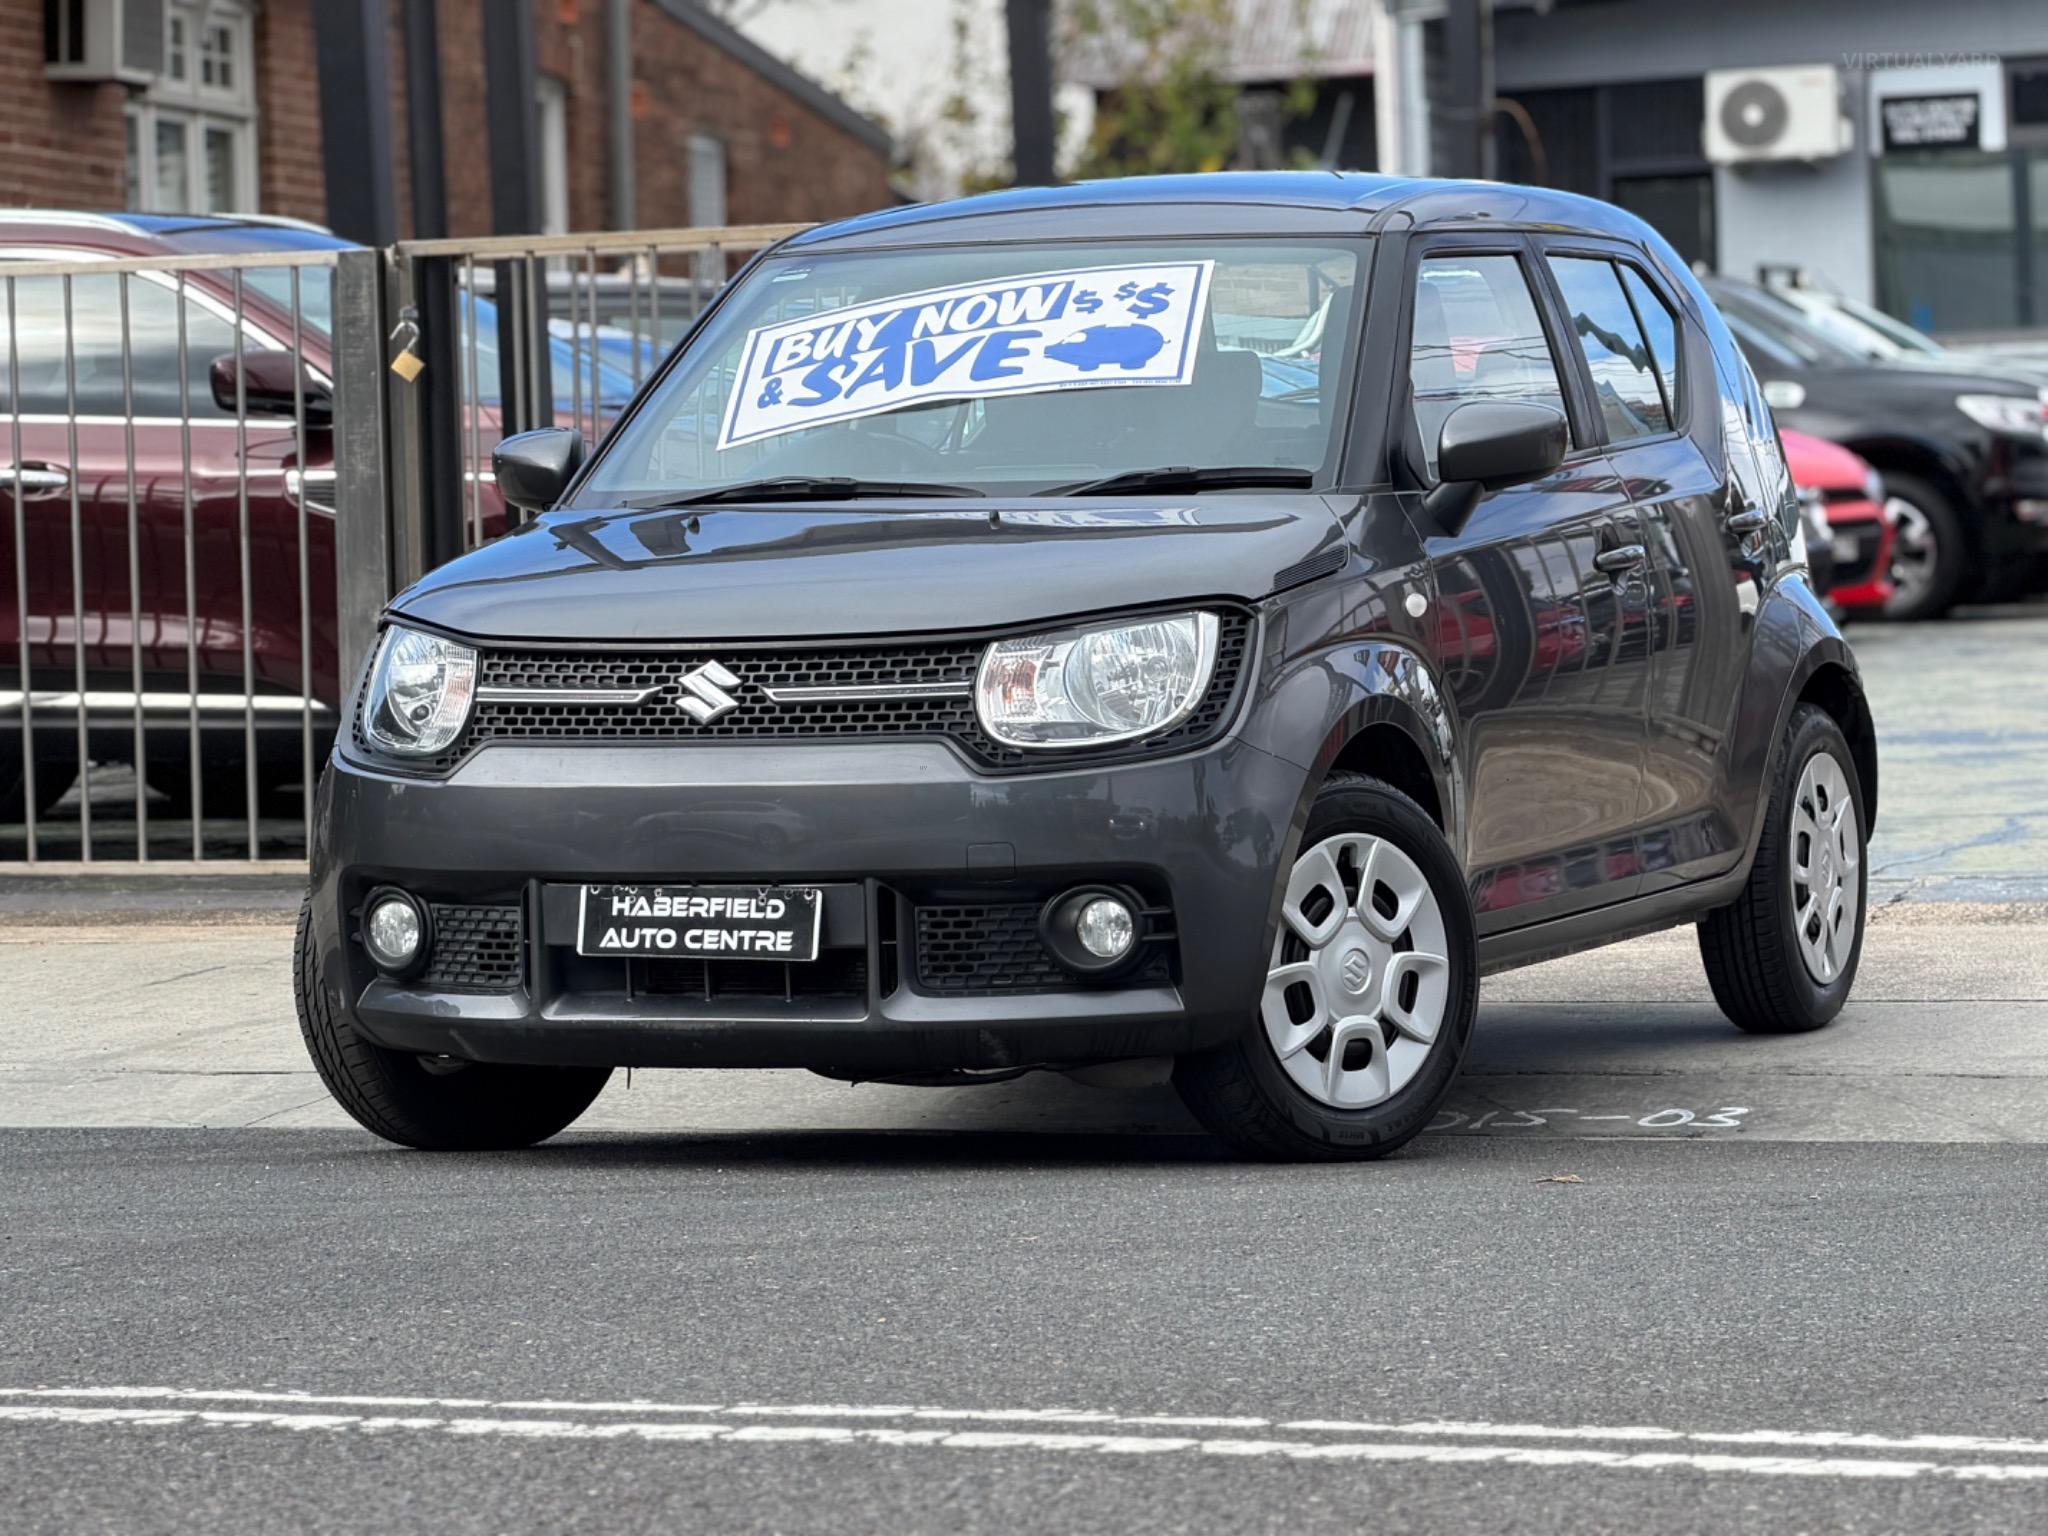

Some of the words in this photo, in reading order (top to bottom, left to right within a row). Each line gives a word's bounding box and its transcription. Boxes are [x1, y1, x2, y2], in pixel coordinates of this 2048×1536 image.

[773, 312, 900, 374] BUY
[913, 284, 1063, 340] NOW
[757, 377, 782, 409] &
[787, 329, 1042, 407] SAVE
[611, 896, 787, 919] HABERFIELD
[599, 927, 678, 949] AUTO
[684, 929, 794, 951] CENTRE
